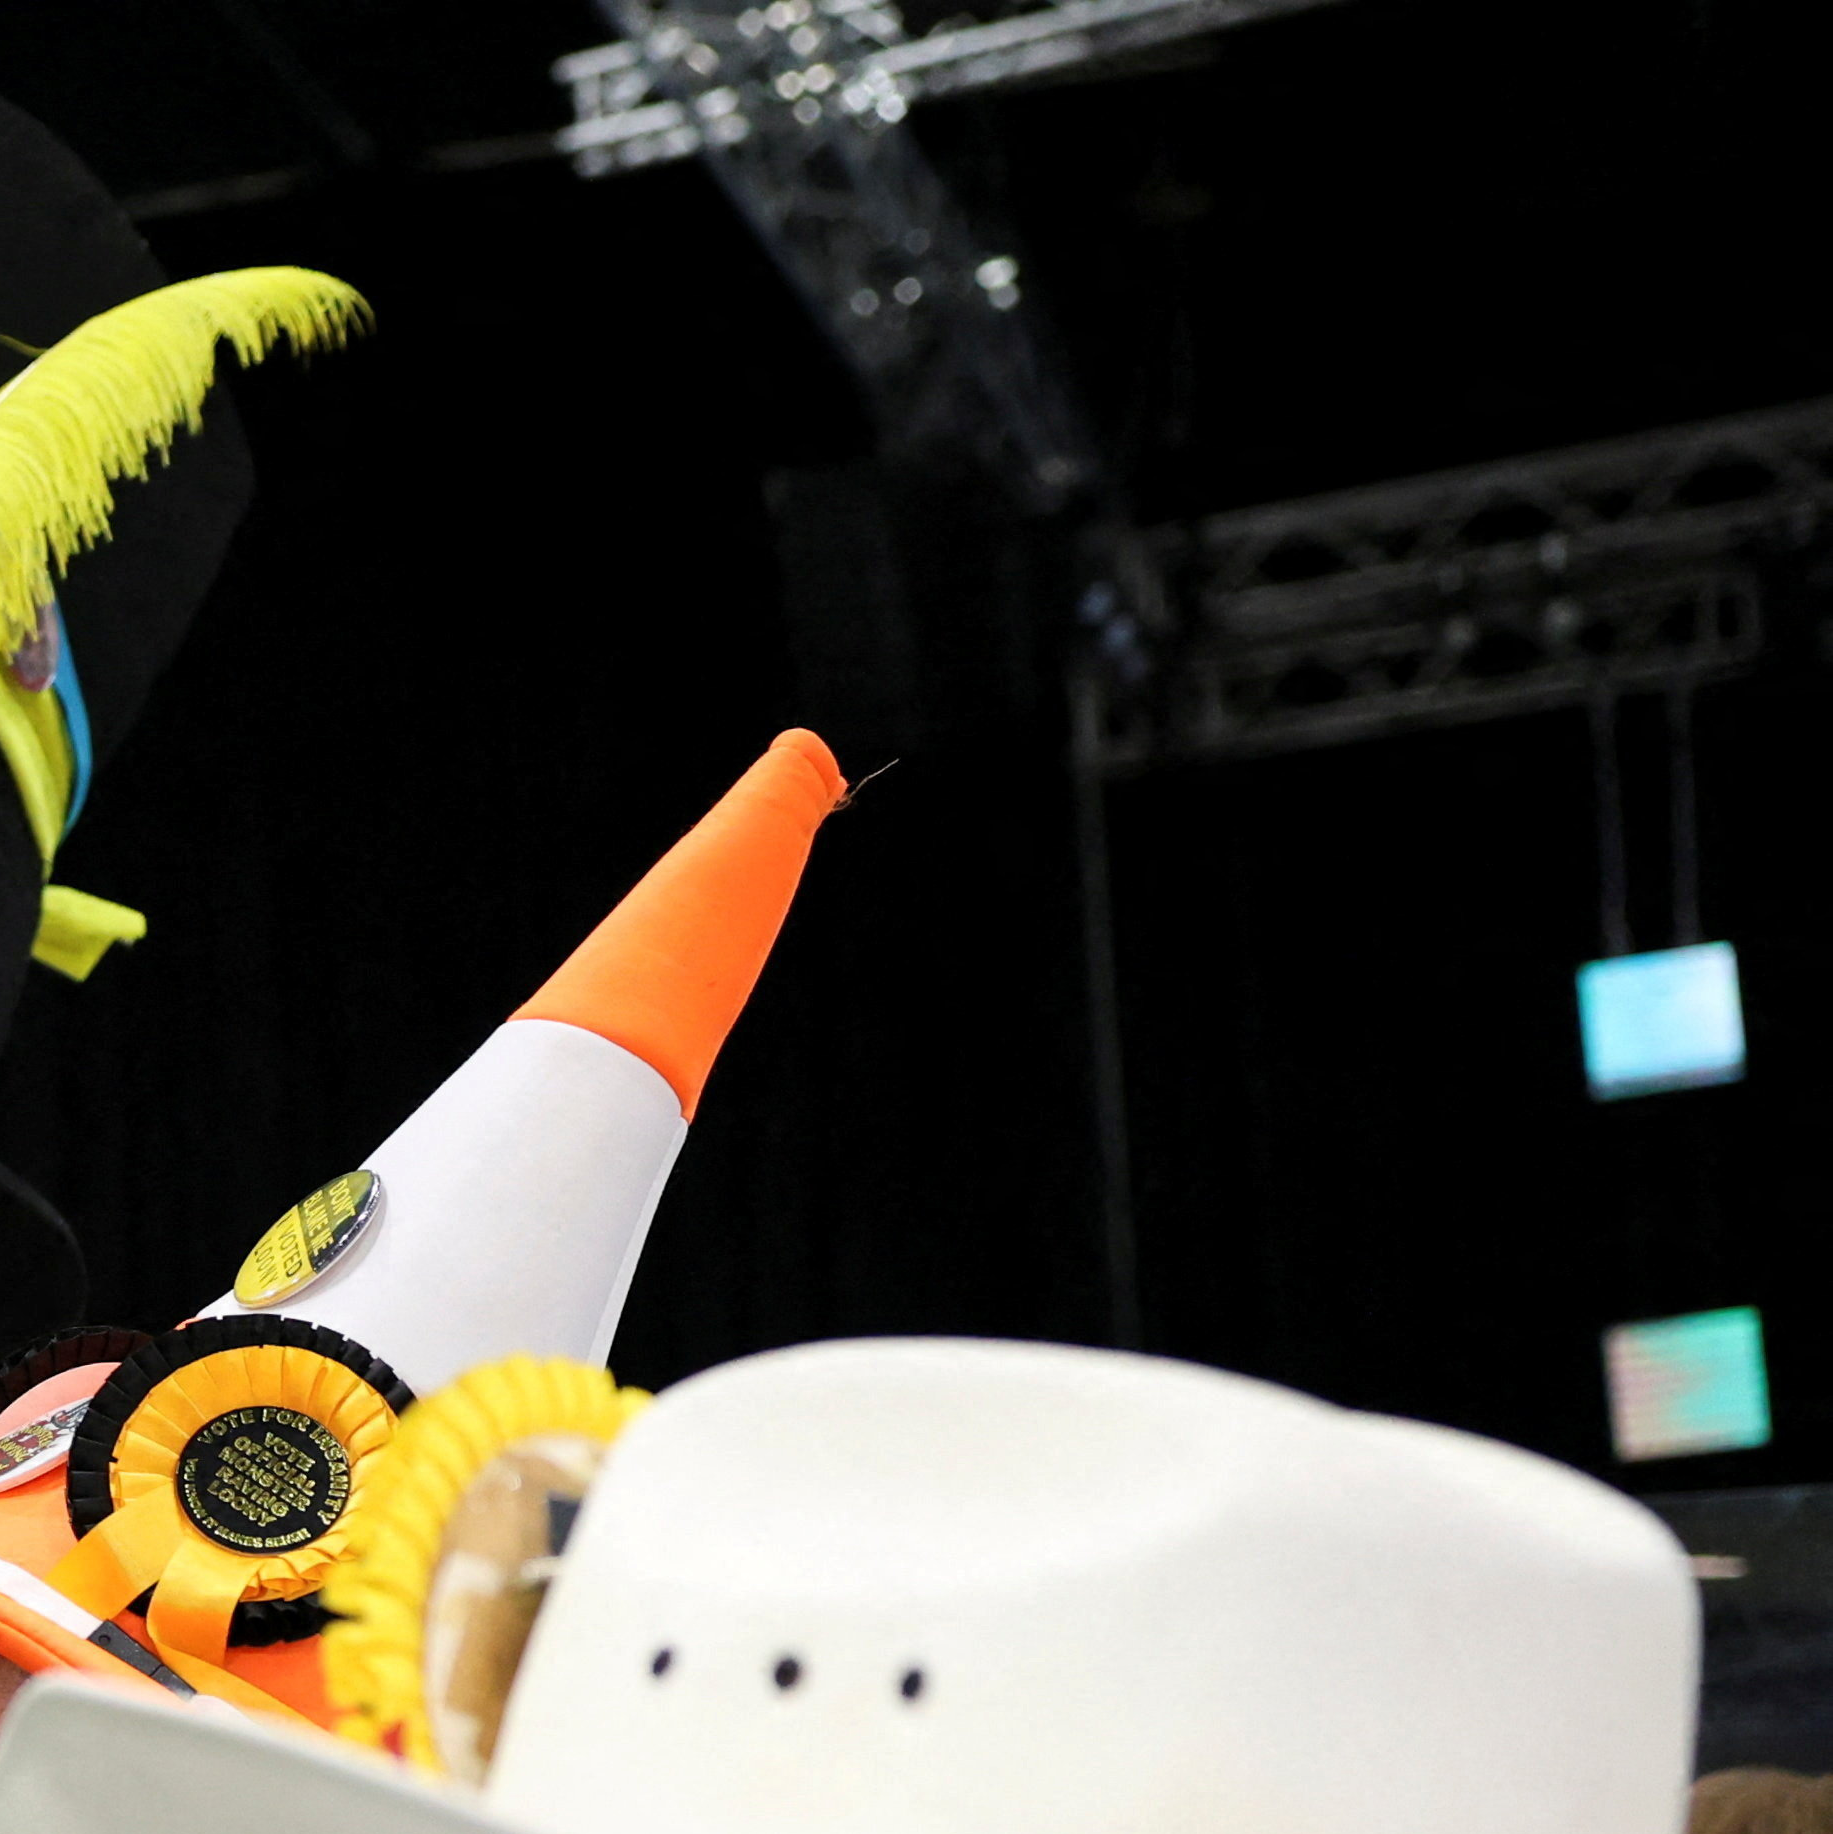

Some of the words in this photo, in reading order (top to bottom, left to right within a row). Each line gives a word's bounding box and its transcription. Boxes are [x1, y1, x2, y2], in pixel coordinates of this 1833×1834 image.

[303, 1189, 329, 1237] BLAME
[329, 1178, 357, 1227] DON'T
[254, 1237, 279, 1289] LOONY
[278, 1229, 303, 1278] VOTED
[308, 1230, 334, 1257] ME
[197, 1409, 255, 1444] VOTE
[263, 1408, 311, 1432] FOR
[309, 1425, 350, 1525] INSANITY
[234, 1436, 316, 1497] OFFICIAL
[264, 1431, 316, 1472] VOTE
[207, 1480, 277, 1527] LOONY
[215, 1465, 290, 1517] RAVING
[218, 1446, 311, 1512] MONSTER
